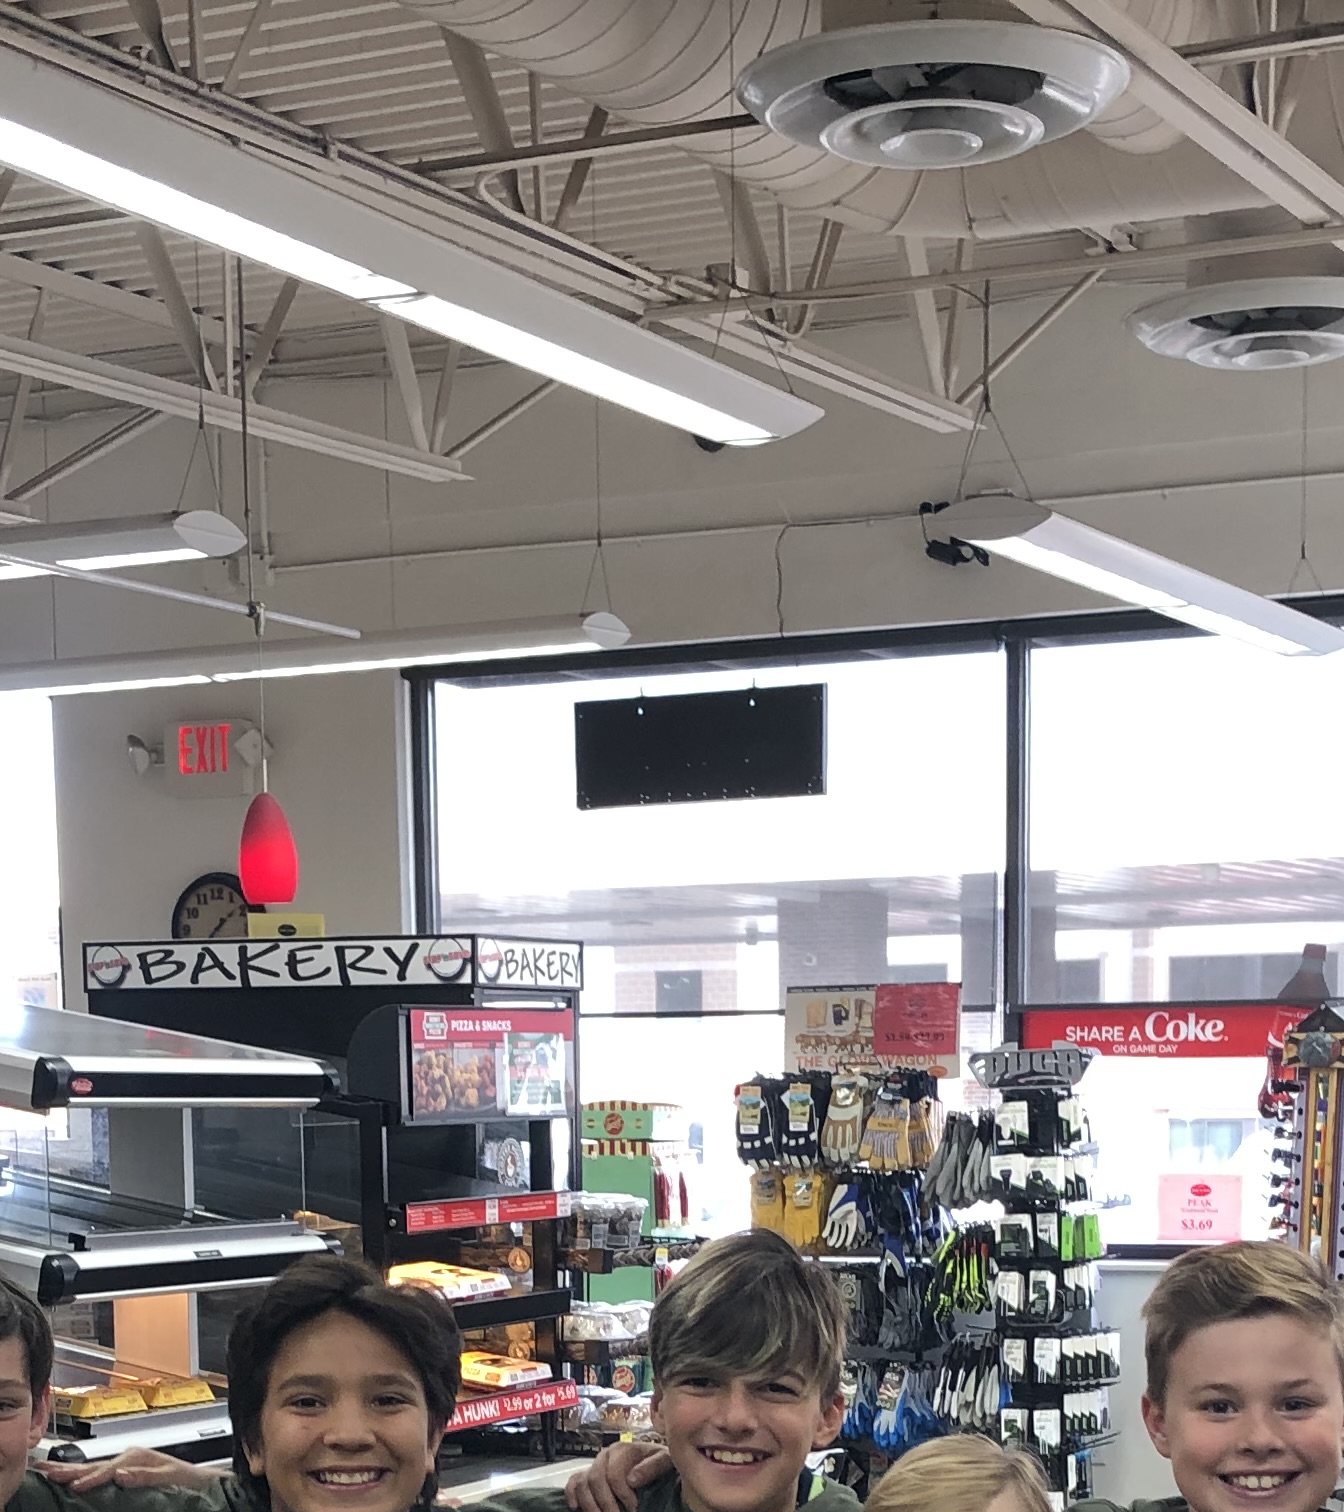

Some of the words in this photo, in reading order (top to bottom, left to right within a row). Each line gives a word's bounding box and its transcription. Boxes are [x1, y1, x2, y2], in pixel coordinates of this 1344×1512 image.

[178, 724, 231, 775] EXIT
[137, 942, 420, 987] BAKERY
[504, 948, 581, 985] BAKERY
[451, 1020, 474, 1031] PIZZA
[482, 1020, 511, 1031] SNACKS
[1065, 1026, 1124, 1041] SHARE
[1129, 1026, 1142, 1041] A
[1113, 1044, 1127, 1053] ON
[1130, 1044, 1156, 1053] GAME
[1159, 1044, 1178, 1054] DAY
[796, 1055, 822, 1068] THE
[881, 1054, 937, 1066] WAGON
[1181, 1219, 1212, 1230] $3.69
[463, 1400, 500, 1422] HUNK!
[523, 1399, 533, 1411] or
[534, 1393, 542, 1408] 2
[542, 1392, 556, 1407] for
